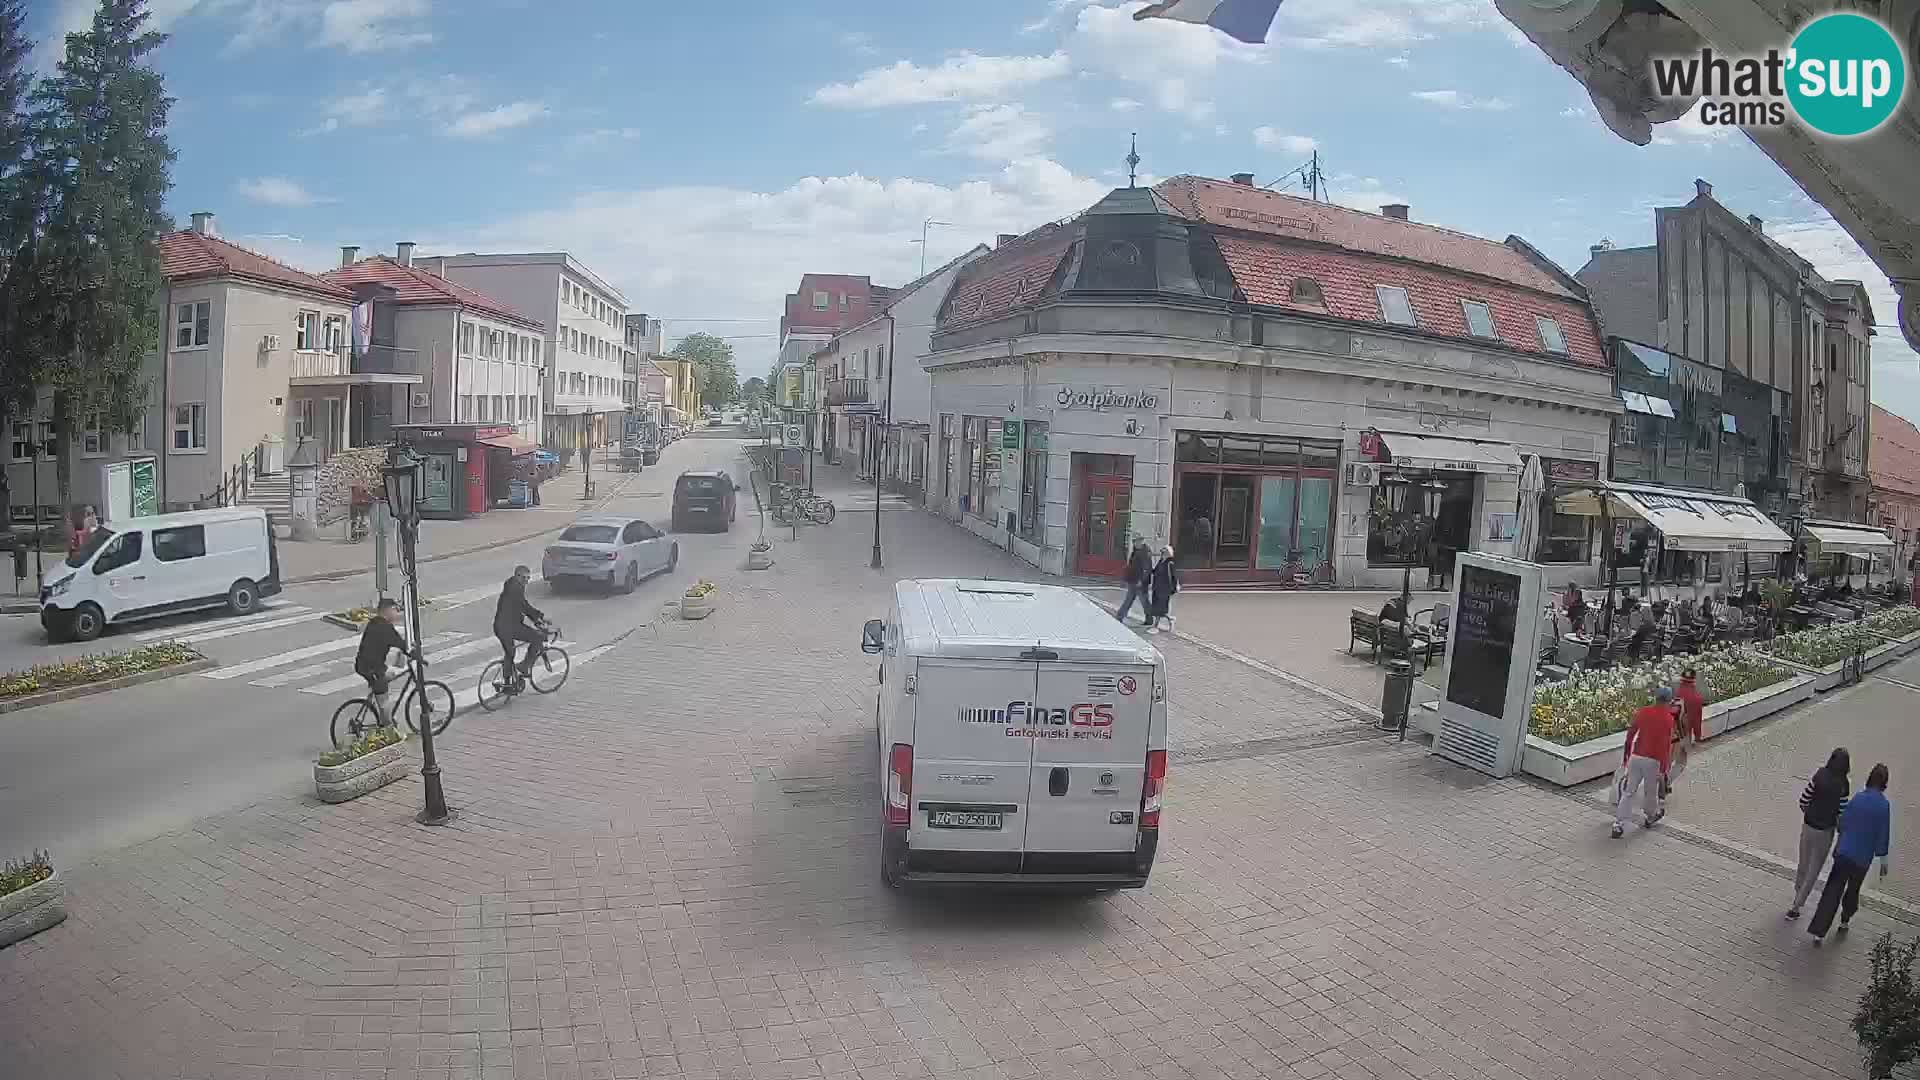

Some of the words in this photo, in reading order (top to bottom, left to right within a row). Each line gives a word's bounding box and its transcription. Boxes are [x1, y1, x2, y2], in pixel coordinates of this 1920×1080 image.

[1006, 701, 1114, 727] FinaGS
[1005, 727, 1069, 739] Gotovinski
[1072, 729, 1112, 740] servisi
